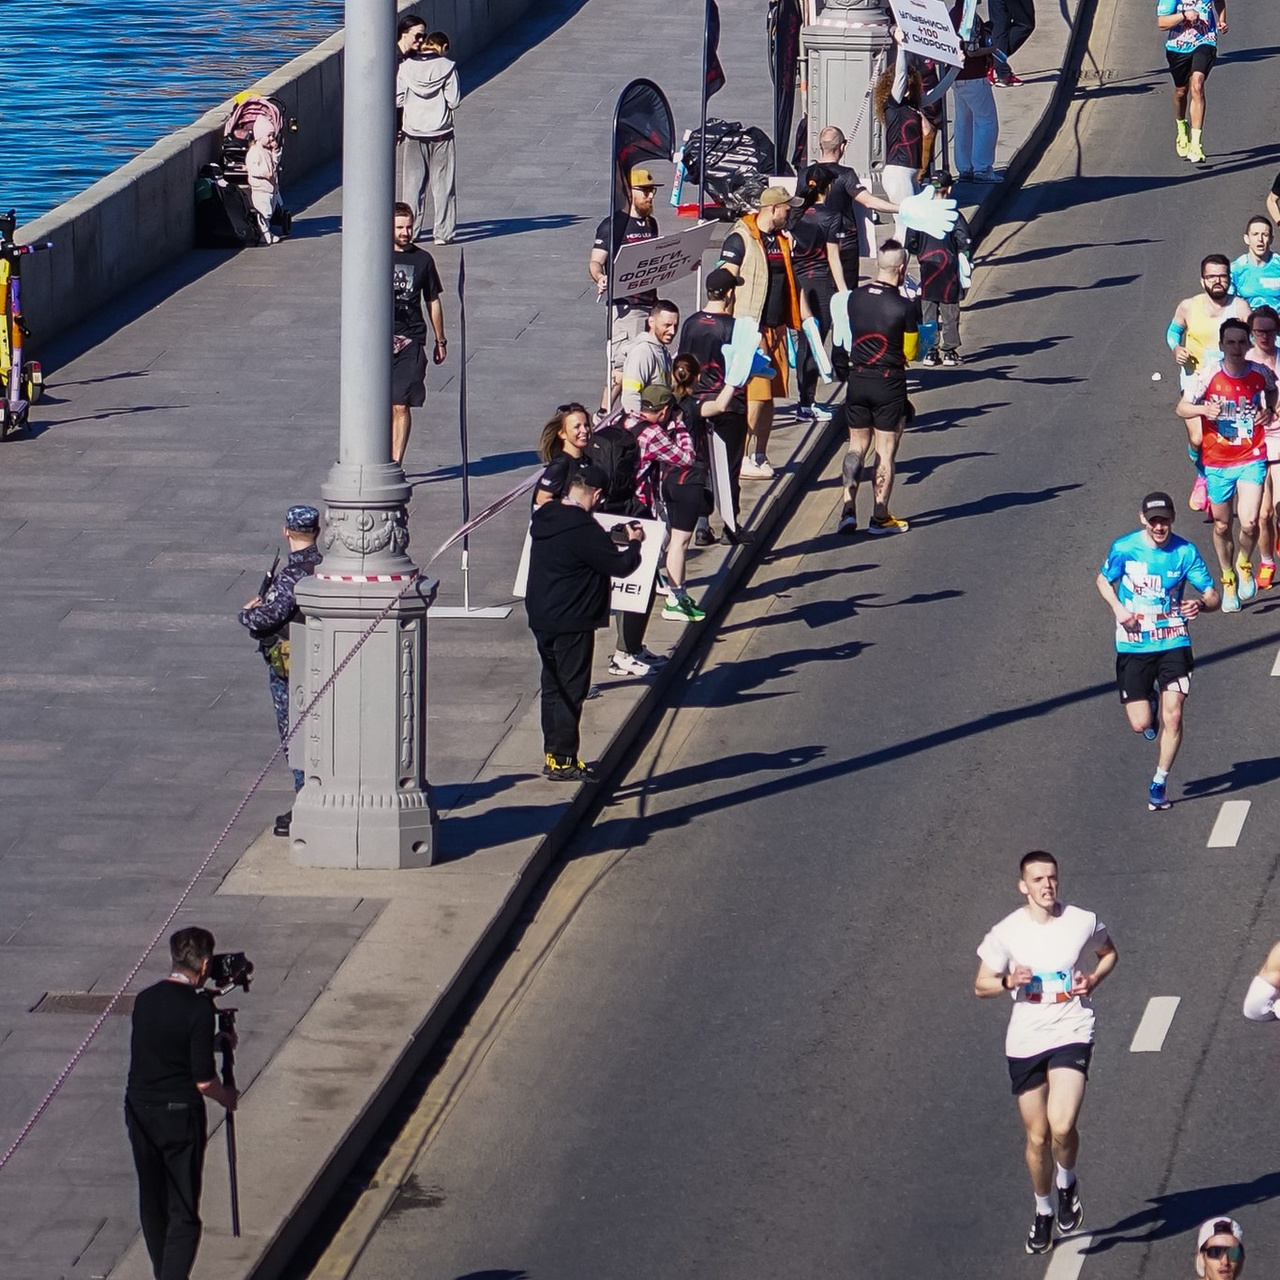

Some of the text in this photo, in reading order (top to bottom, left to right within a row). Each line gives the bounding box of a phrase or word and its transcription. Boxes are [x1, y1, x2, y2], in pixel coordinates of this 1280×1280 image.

[899, 10, 950, 33] УЛЫБНИСЬ!
[918, 26, 939, 39] +100
[912, 33, 958, 55] СКОРОСТИ
[627, 270, 676, 290] БЕГИ!
[611, 582, 641, 595] НЕ!
